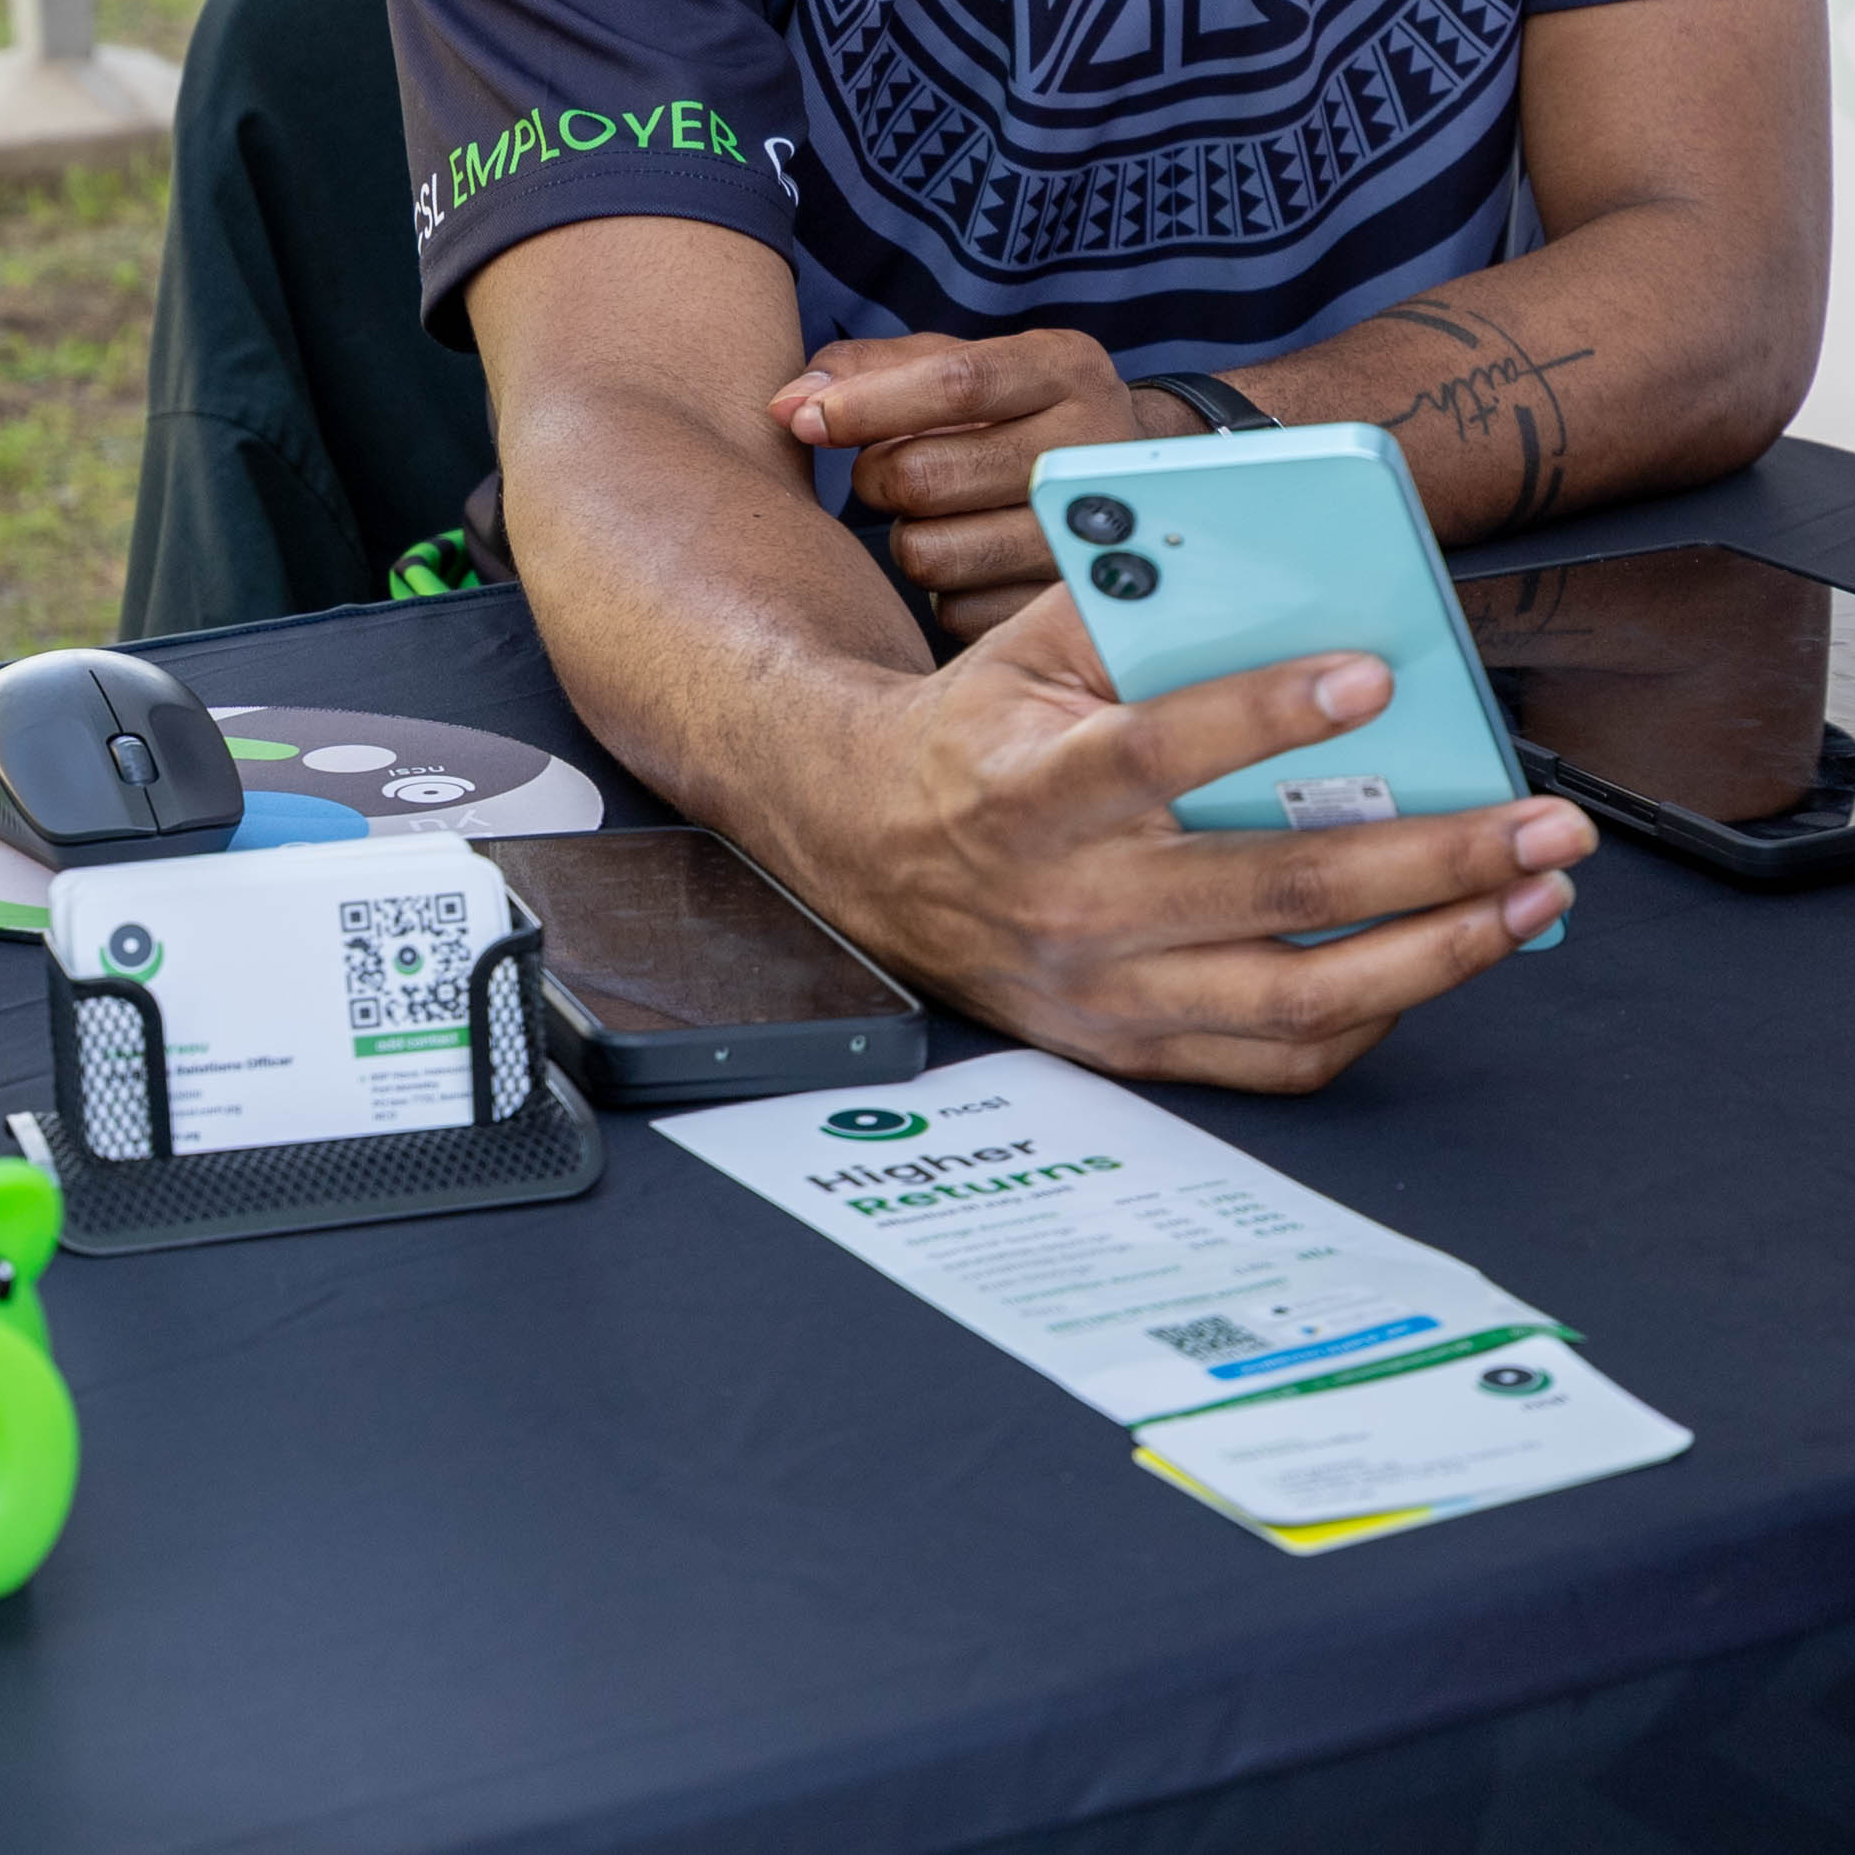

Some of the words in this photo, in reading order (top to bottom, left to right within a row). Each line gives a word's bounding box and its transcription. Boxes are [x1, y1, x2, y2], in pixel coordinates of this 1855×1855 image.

[449, 100, 747, 209] EMPLOYER
[388, 764, 445, 777] ncsl
[937, 1094, 1012, 1120] ncsl
[807, 1138, 1036, 1193] Higher
[847, 1154, 1124, 1217] Returns
